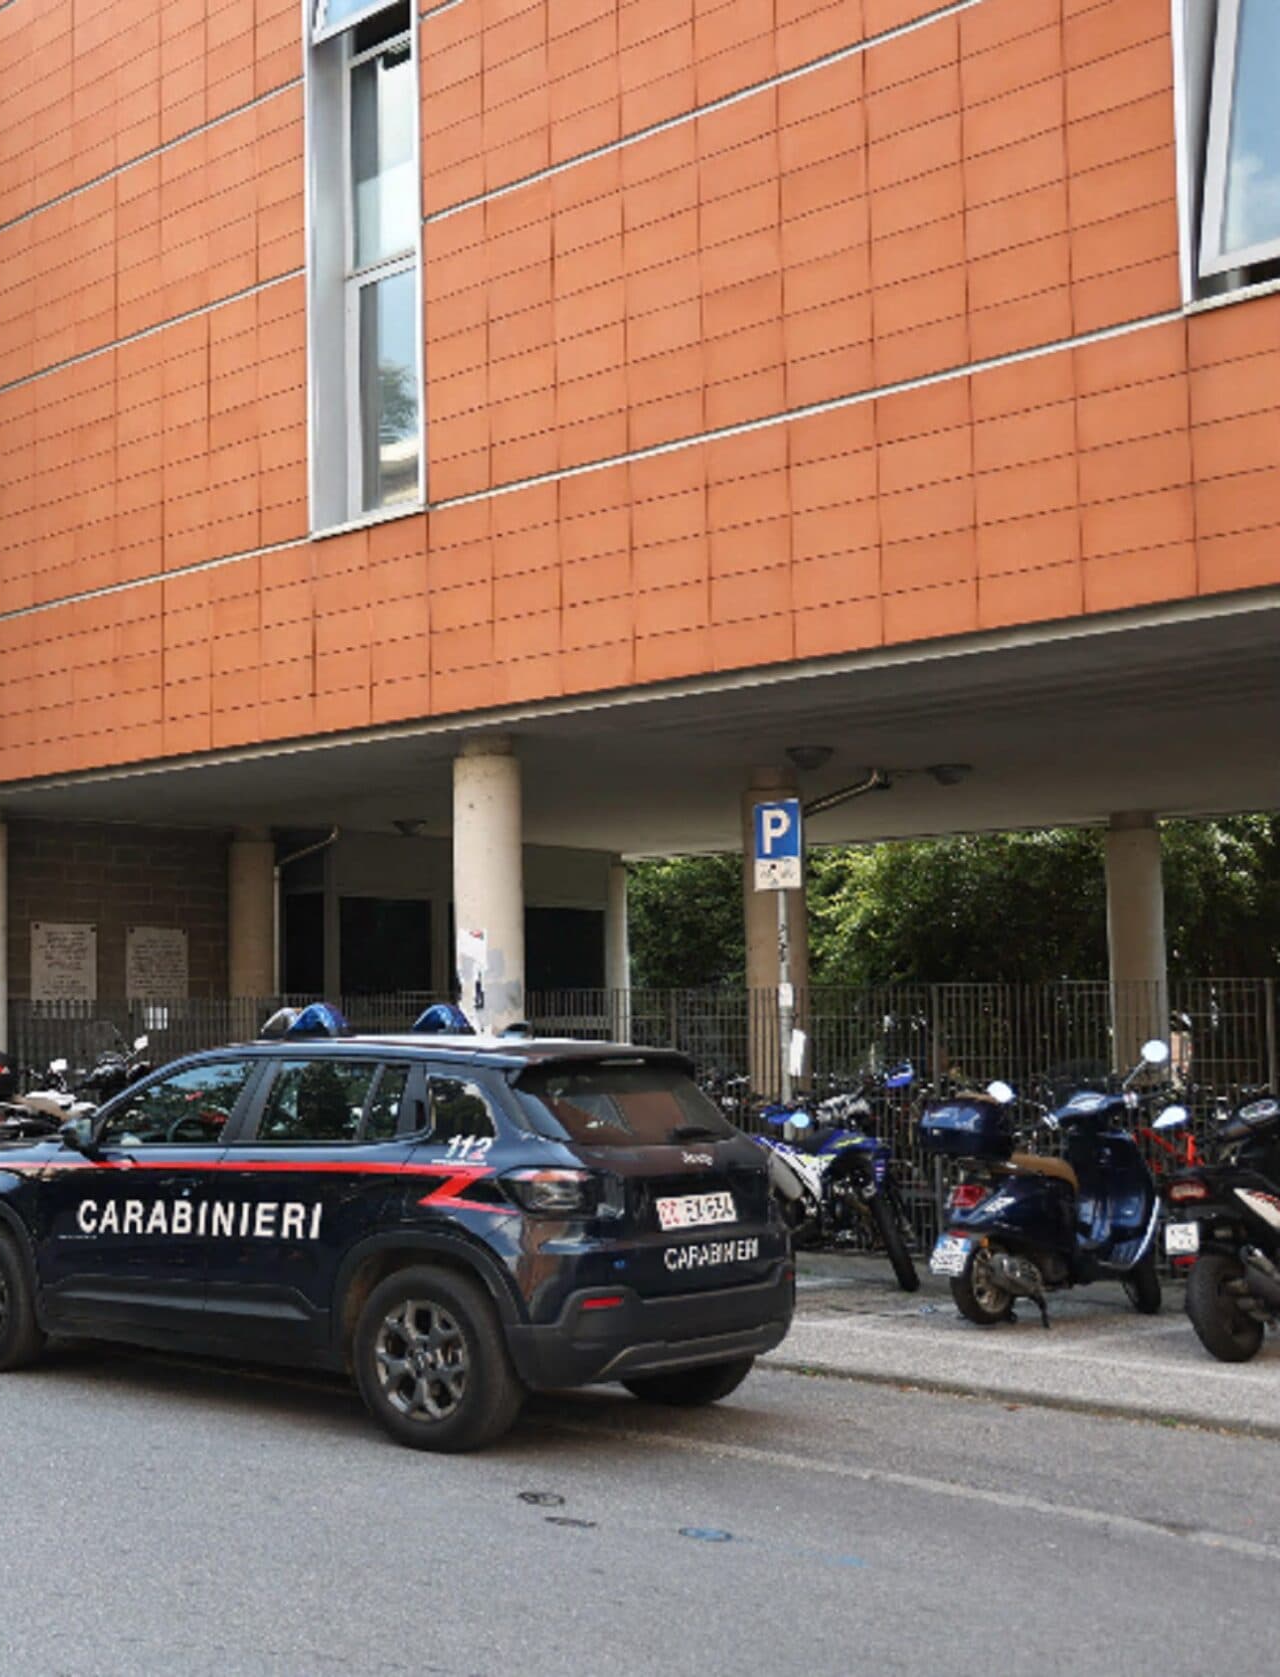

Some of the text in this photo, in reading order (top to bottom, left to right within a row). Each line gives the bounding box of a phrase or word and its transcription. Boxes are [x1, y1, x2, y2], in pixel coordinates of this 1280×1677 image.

[762, 809, 791, 855] P
[444, 1134, 494, 1161] 112
[77, 1199, 323, 1240] CARABINIERI
